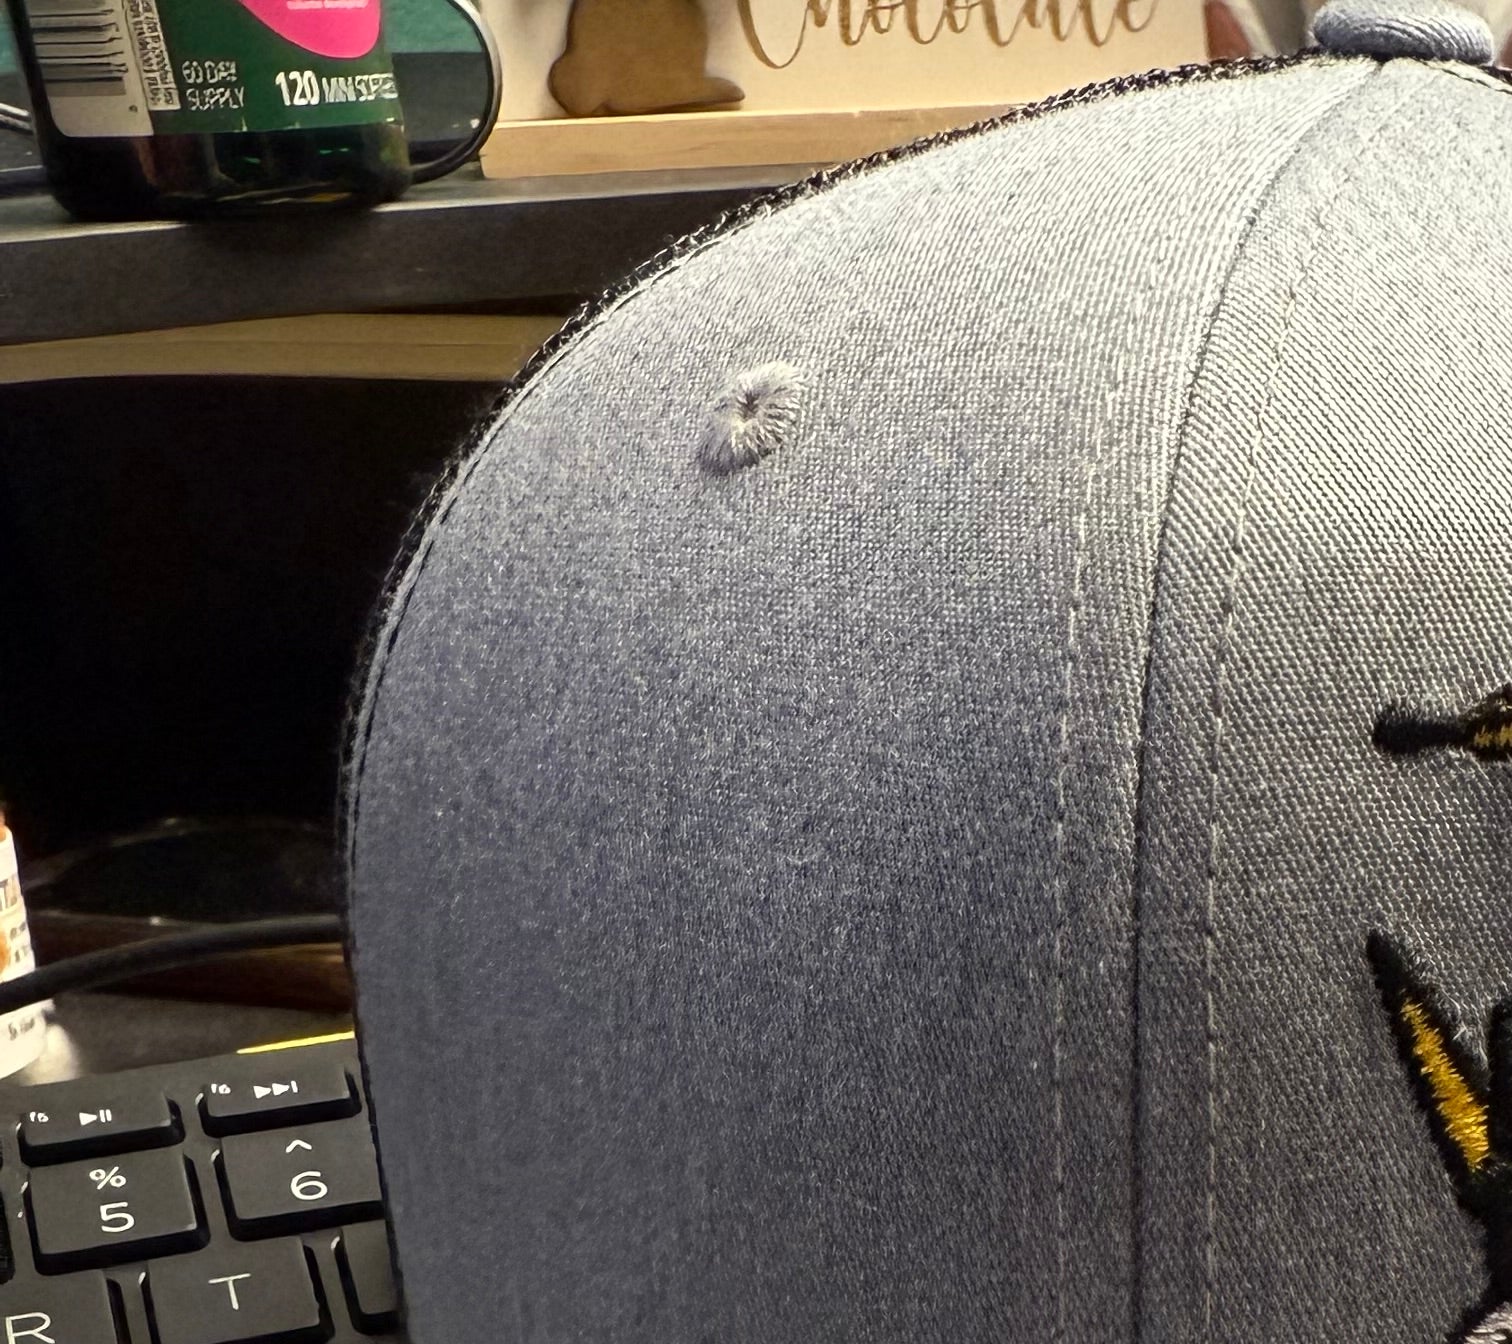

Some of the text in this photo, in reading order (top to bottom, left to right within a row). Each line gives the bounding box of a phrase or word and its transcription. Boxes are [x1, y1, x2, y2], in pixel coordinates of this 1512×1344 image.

[275, 71, 320, 106] 120
[89, 1167, 126, 1189] %
[291, 1171, 327, 1200] 6
[100, 1202, 134, 1232] 5
[209, 1273, 250, 1310] T
